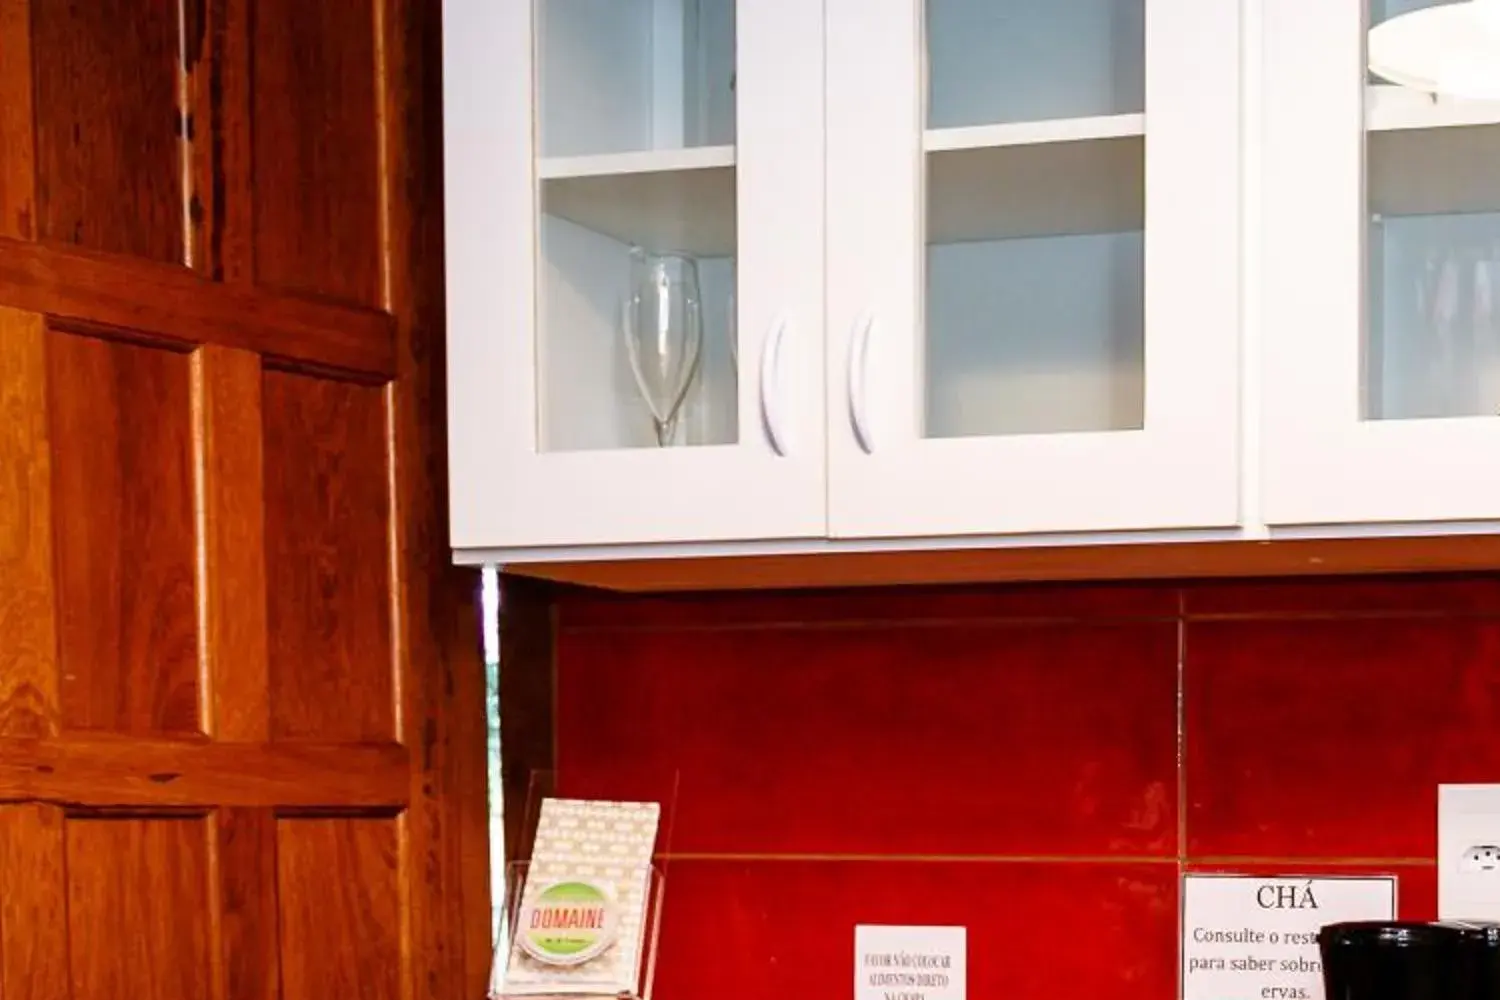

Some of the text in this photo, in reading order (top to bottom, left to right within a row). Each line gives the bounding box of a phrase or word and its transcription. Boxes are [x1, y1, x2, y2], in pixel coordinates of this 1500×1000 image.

[1256, 879, 1319, 909] CHÁ
[530, 907, 606, 929] DOMAINE
[1193, 927, 1318, 945] Consulte o rest
[1189, 957, 1225, 973] para
[1230, 956, 1277, 972] saber
[1261, 986, 1311, 1000] ervas.
